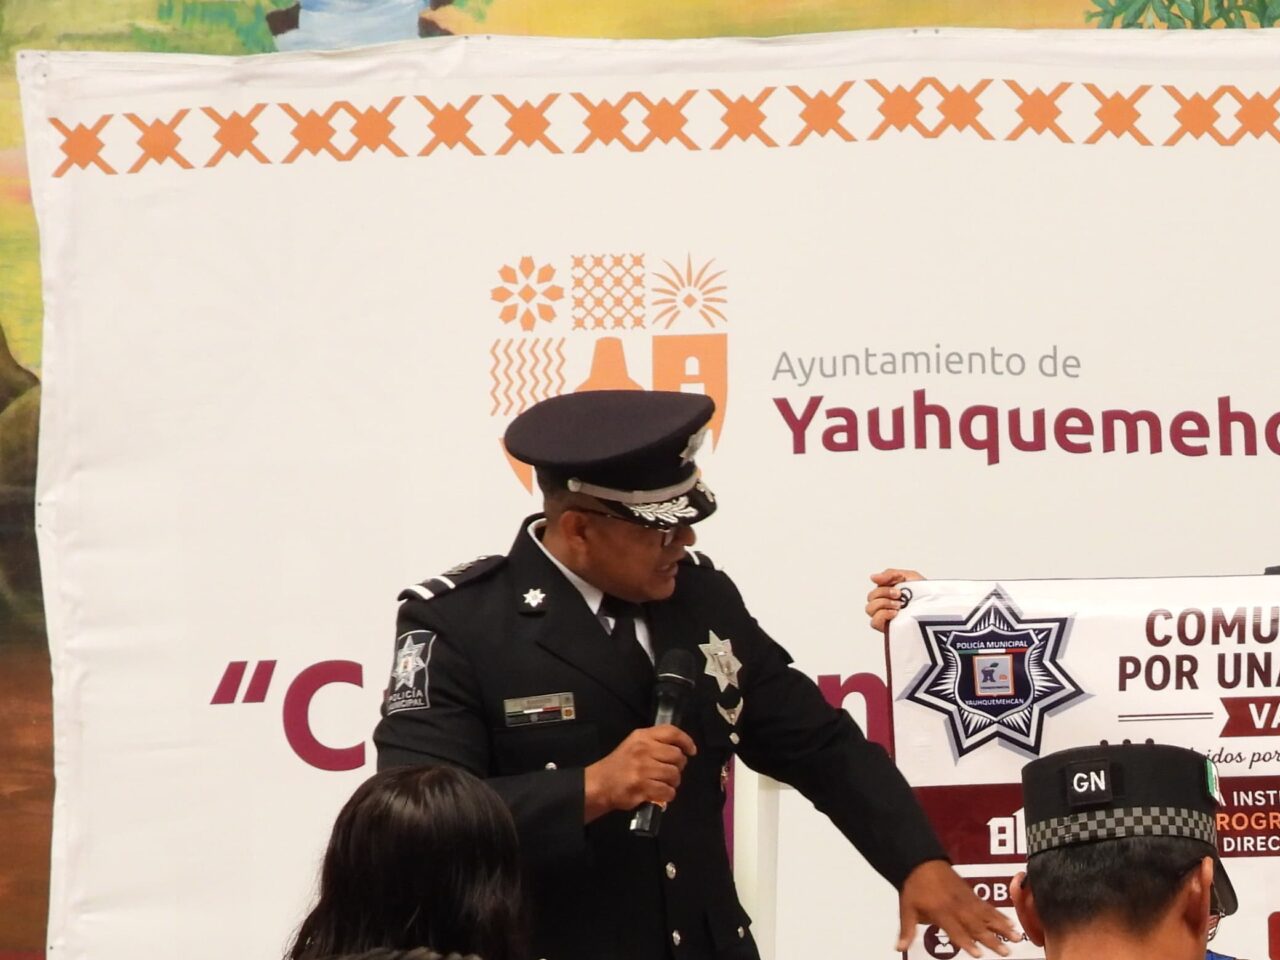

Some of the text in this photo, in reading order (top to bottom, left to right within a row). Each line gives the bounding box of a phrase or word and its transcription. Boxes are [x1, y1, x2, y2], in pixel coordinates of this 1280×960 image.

[771, 344, 1082, 387] Ayuntamiento de
[956, 640, 1028, 649] POLICÍA MUNICIPAL
[1118, 655, 1200, 692] POR
[1200, 746, 1247, 764] idos
[1073, 770, 1107, 793] GN
[973, 883, 1013, 902] OB
